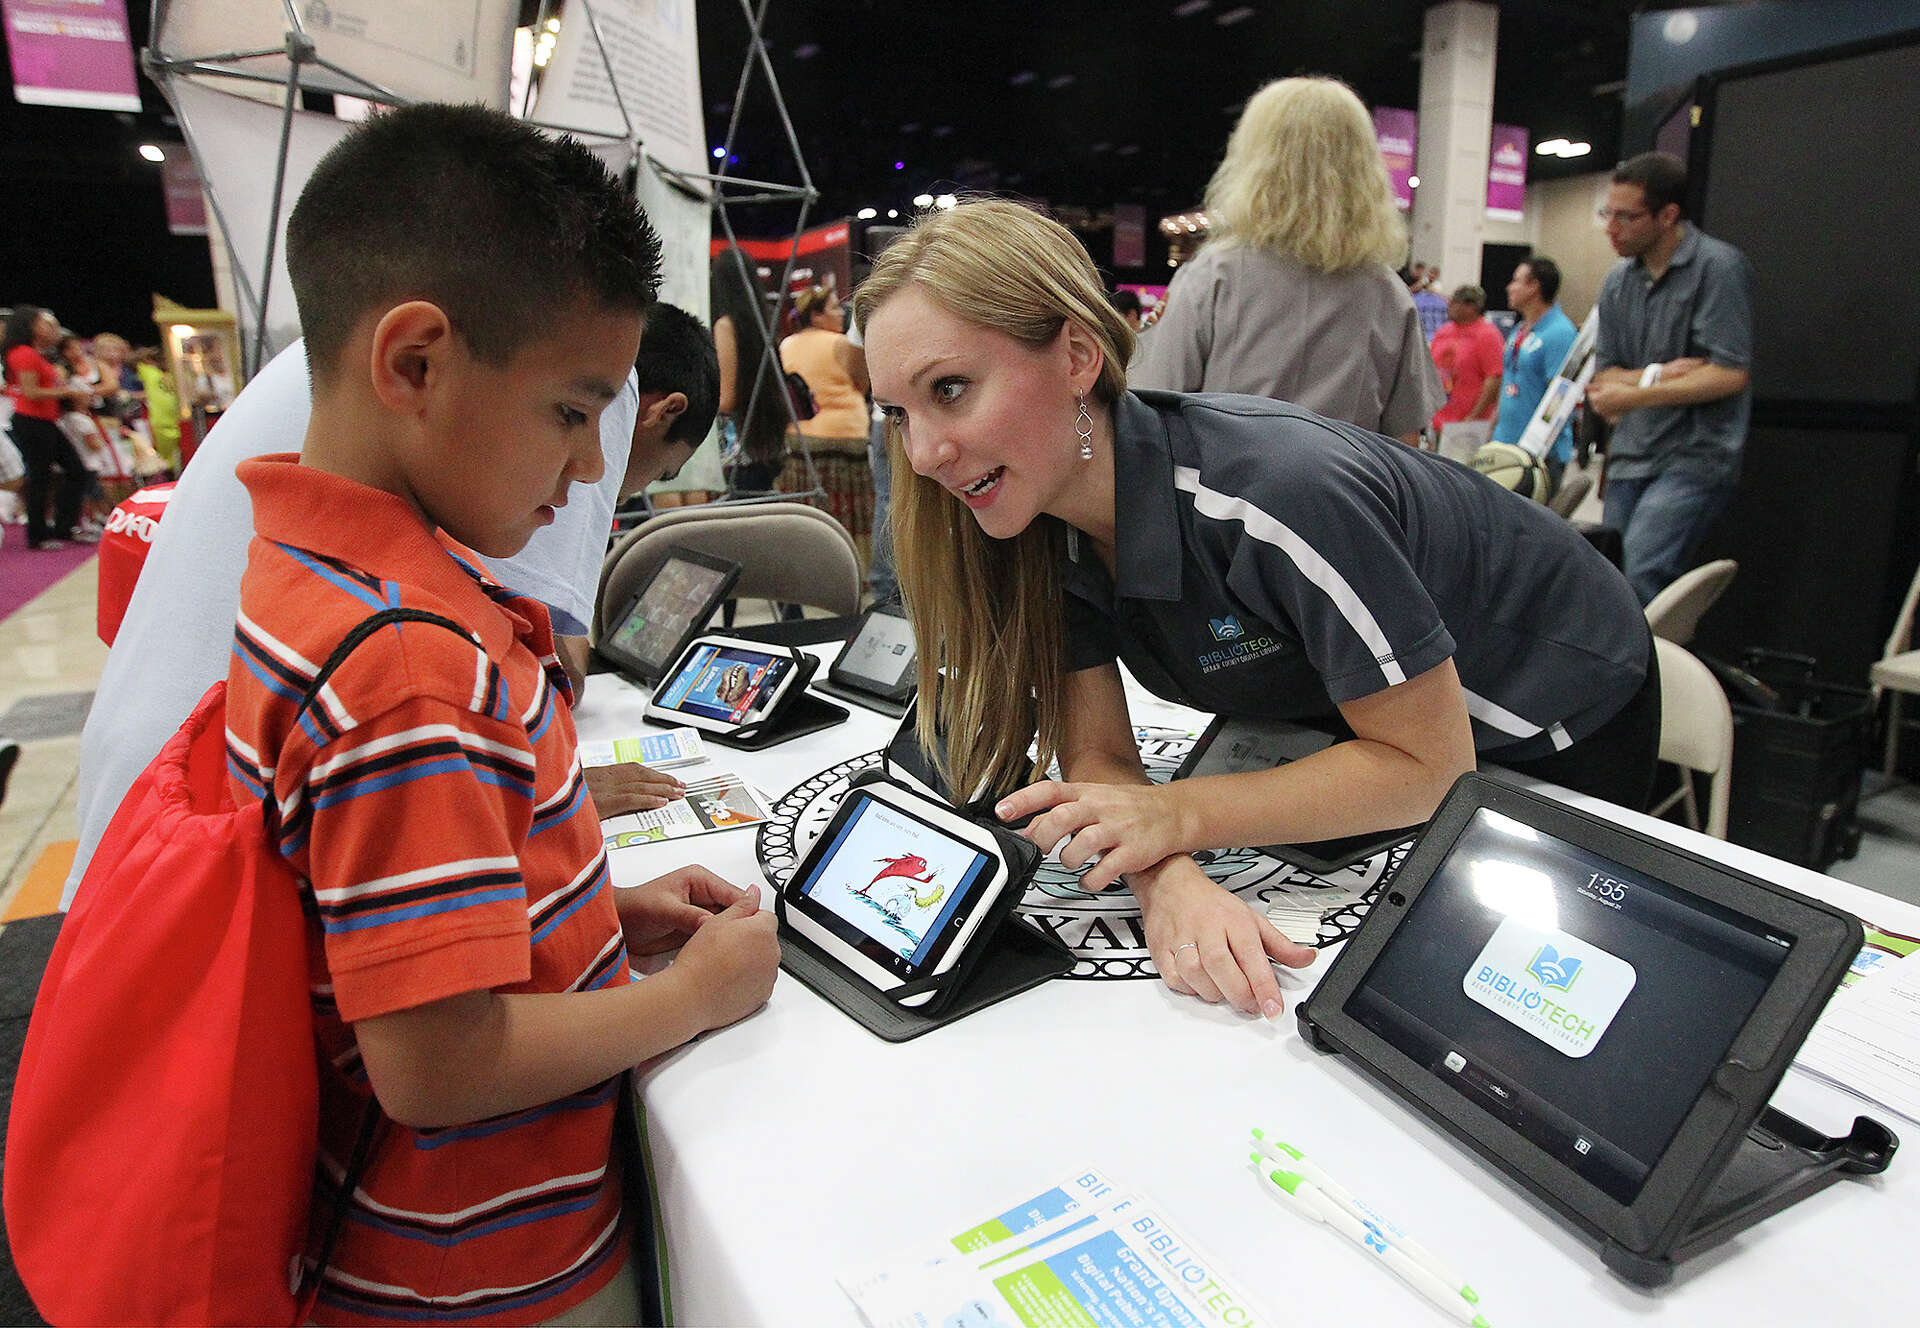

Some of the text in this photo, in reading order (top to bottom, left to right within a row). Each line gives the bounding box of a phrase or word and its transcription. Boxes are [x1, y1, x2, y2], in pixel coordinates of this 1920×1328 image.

[1587, 873, 1629, 901] 1:55
[1476, 965, 1596, 1041] BIBLIOTECH
[1077, 1253, 1115, 1293] Digital
[1117, 1246, 1161, 1289] Grand
